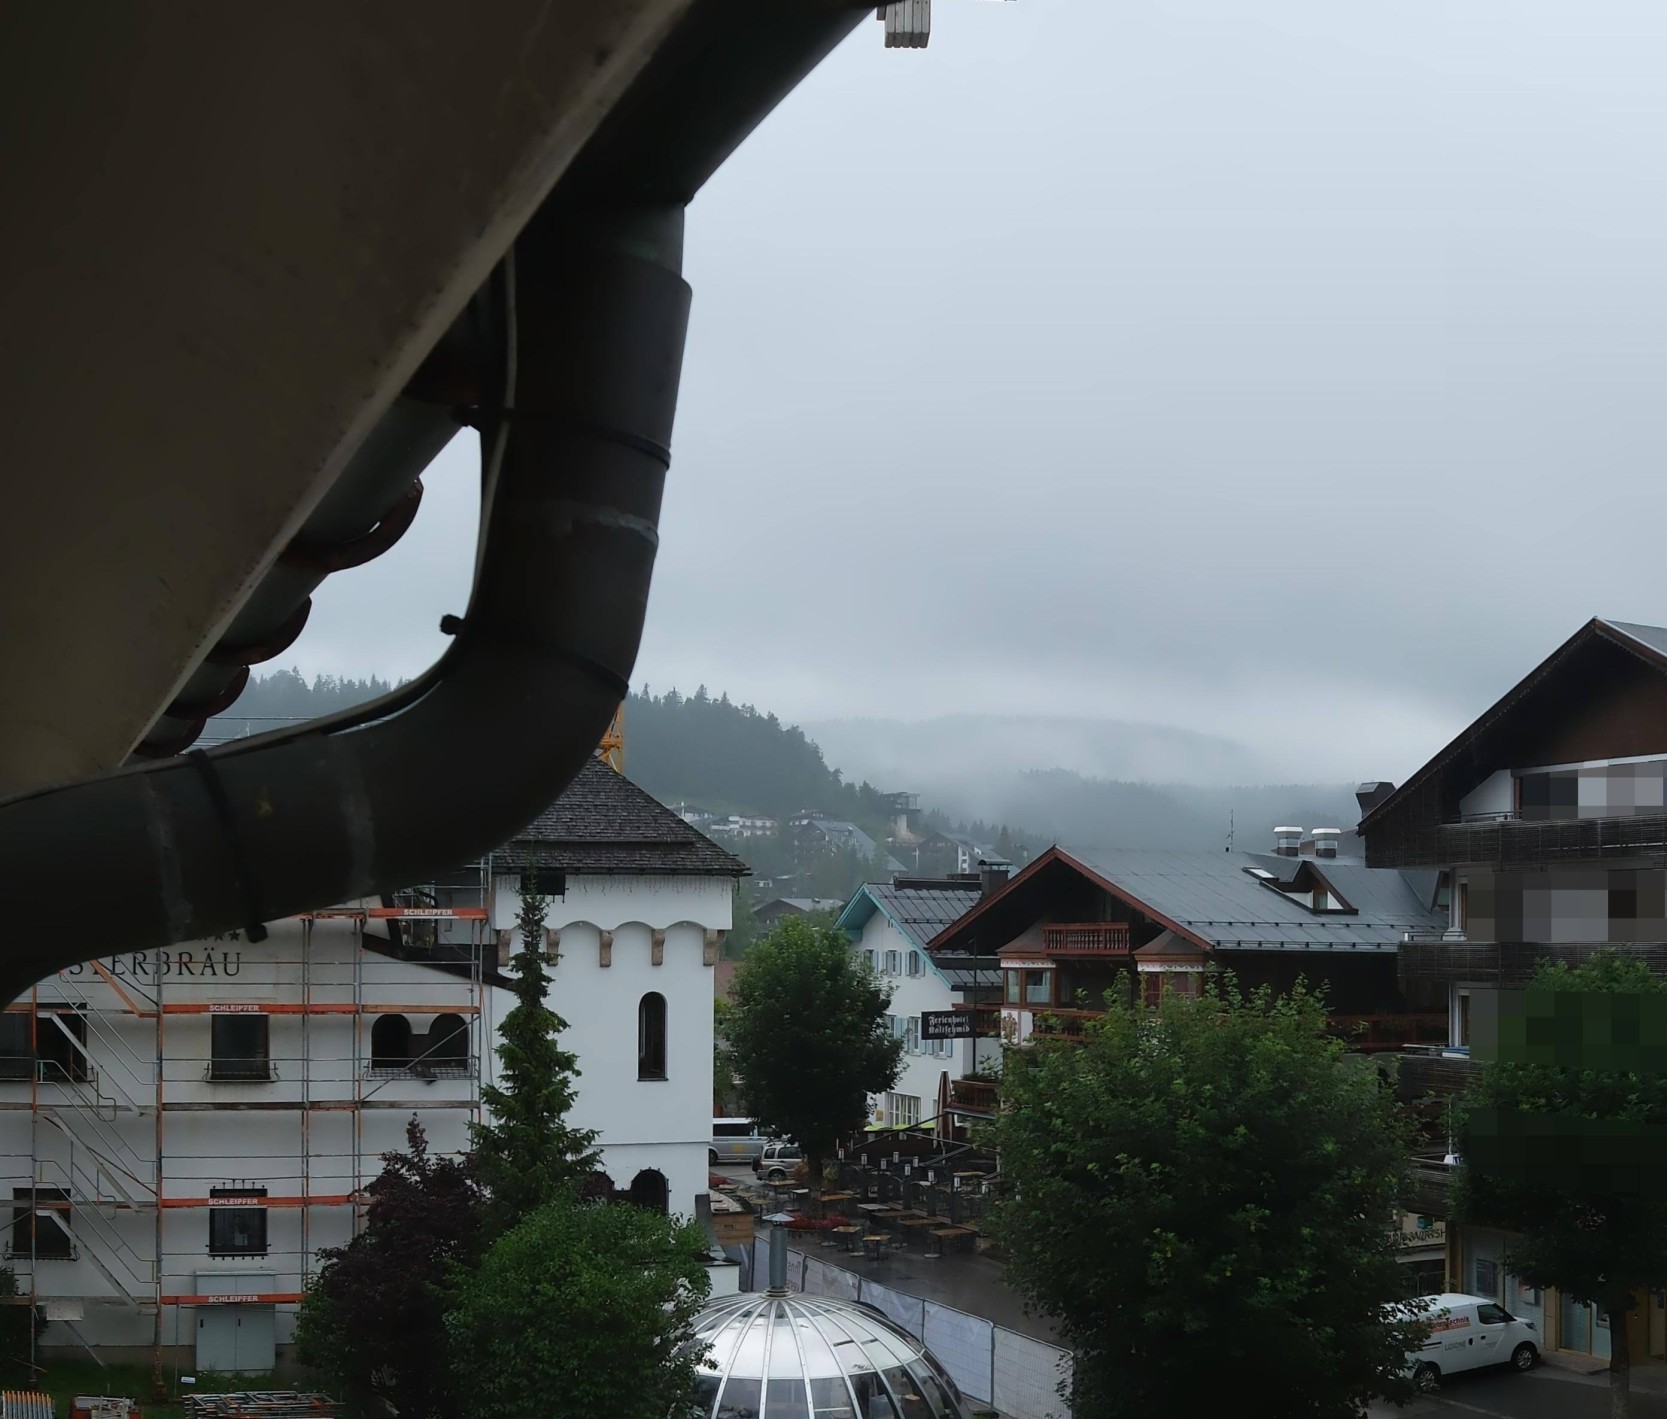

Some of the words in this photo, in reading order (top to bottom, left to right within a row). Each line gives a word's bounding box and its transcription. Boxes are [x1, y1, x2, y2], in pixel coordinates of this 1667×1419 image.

[403, 908, 453, 917] SCHLEIPFER
[208, 1004, 260, 1013] SCHLEIPFER
[207, 1198, 259, 1206] SCHLEIPFER
[208, 1295, 259, 1304] SCHLEIPFER
